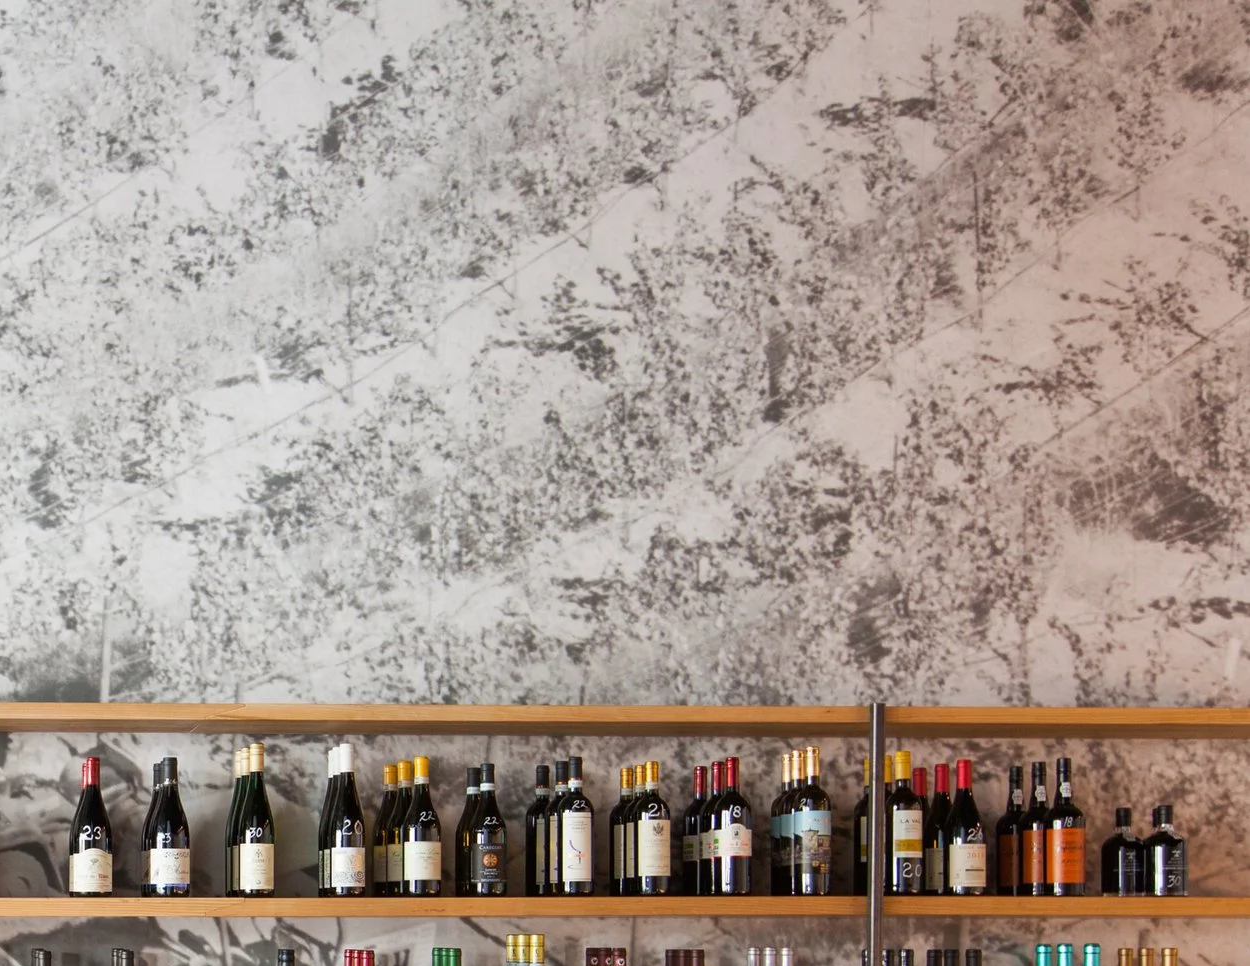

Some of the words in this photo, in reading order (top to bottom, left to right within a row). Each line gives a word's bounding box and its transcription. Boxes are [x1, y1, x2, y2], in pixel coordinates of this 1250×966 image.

[571, 799, 588, 809] 22
[419, 811, 435, 822] 22
[728, 804, 741, 819] 18
[342, 819, 364, 836] 20
[483, 816, 499, 826] 22
[1064, 816, 1074, 828] 18
[82, 824, 102, 841] 23
[902, 861, 922, 878] 20
[1166, 875, 1182, 888] 30
